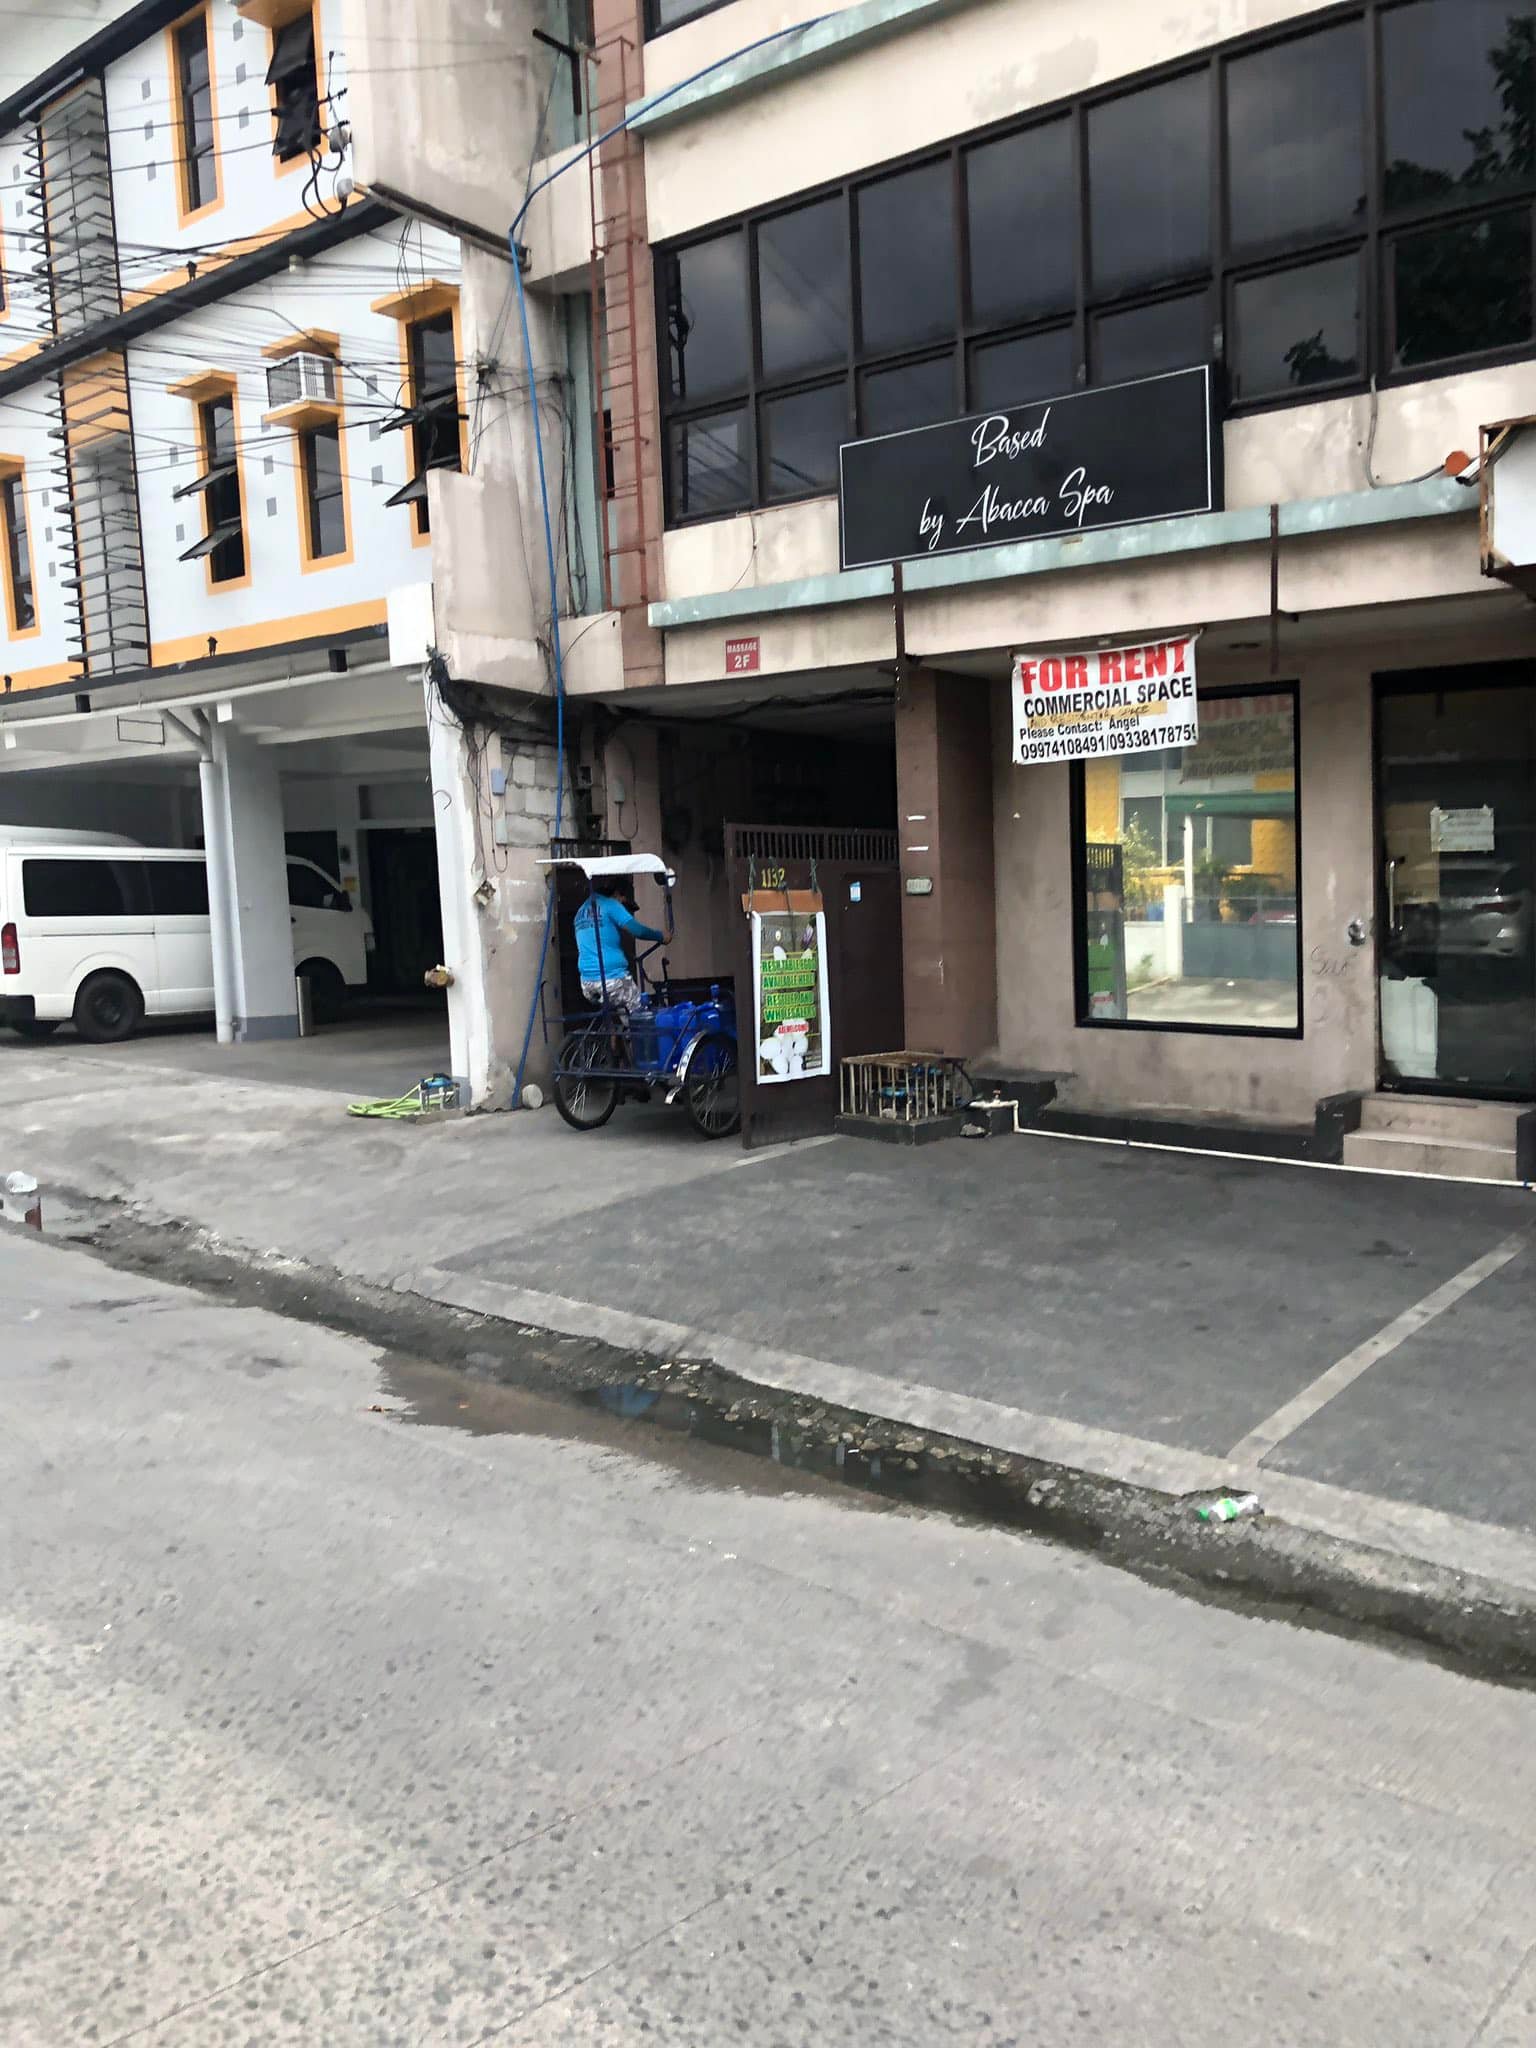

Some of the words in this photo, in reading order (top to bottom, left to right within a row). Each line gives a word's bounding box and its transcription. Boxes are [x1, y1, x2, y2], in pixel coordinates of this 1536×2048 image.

[971, 407, 1051, 467] Based
[919, 498, 945, 550] by
[956, 483, 1050, 535] Abacca
[1058, 466, 1115, 527] Spa
[727, 642, 757, 653] MASSAGE
[734, 654, 750, 669] 2F
[1021, 655, 1089, 695] FOR
[1098, 639, 1190, 685] RENT
[1024, 687, 1132, 718] COMMERCIAL
[1137, 676, 1193, 704] SPACE
[1020, 727, 1055, 740] Please
[1058, 719, 1103, 736] Contact:
[1109, 714, 1140, 731] Angel
